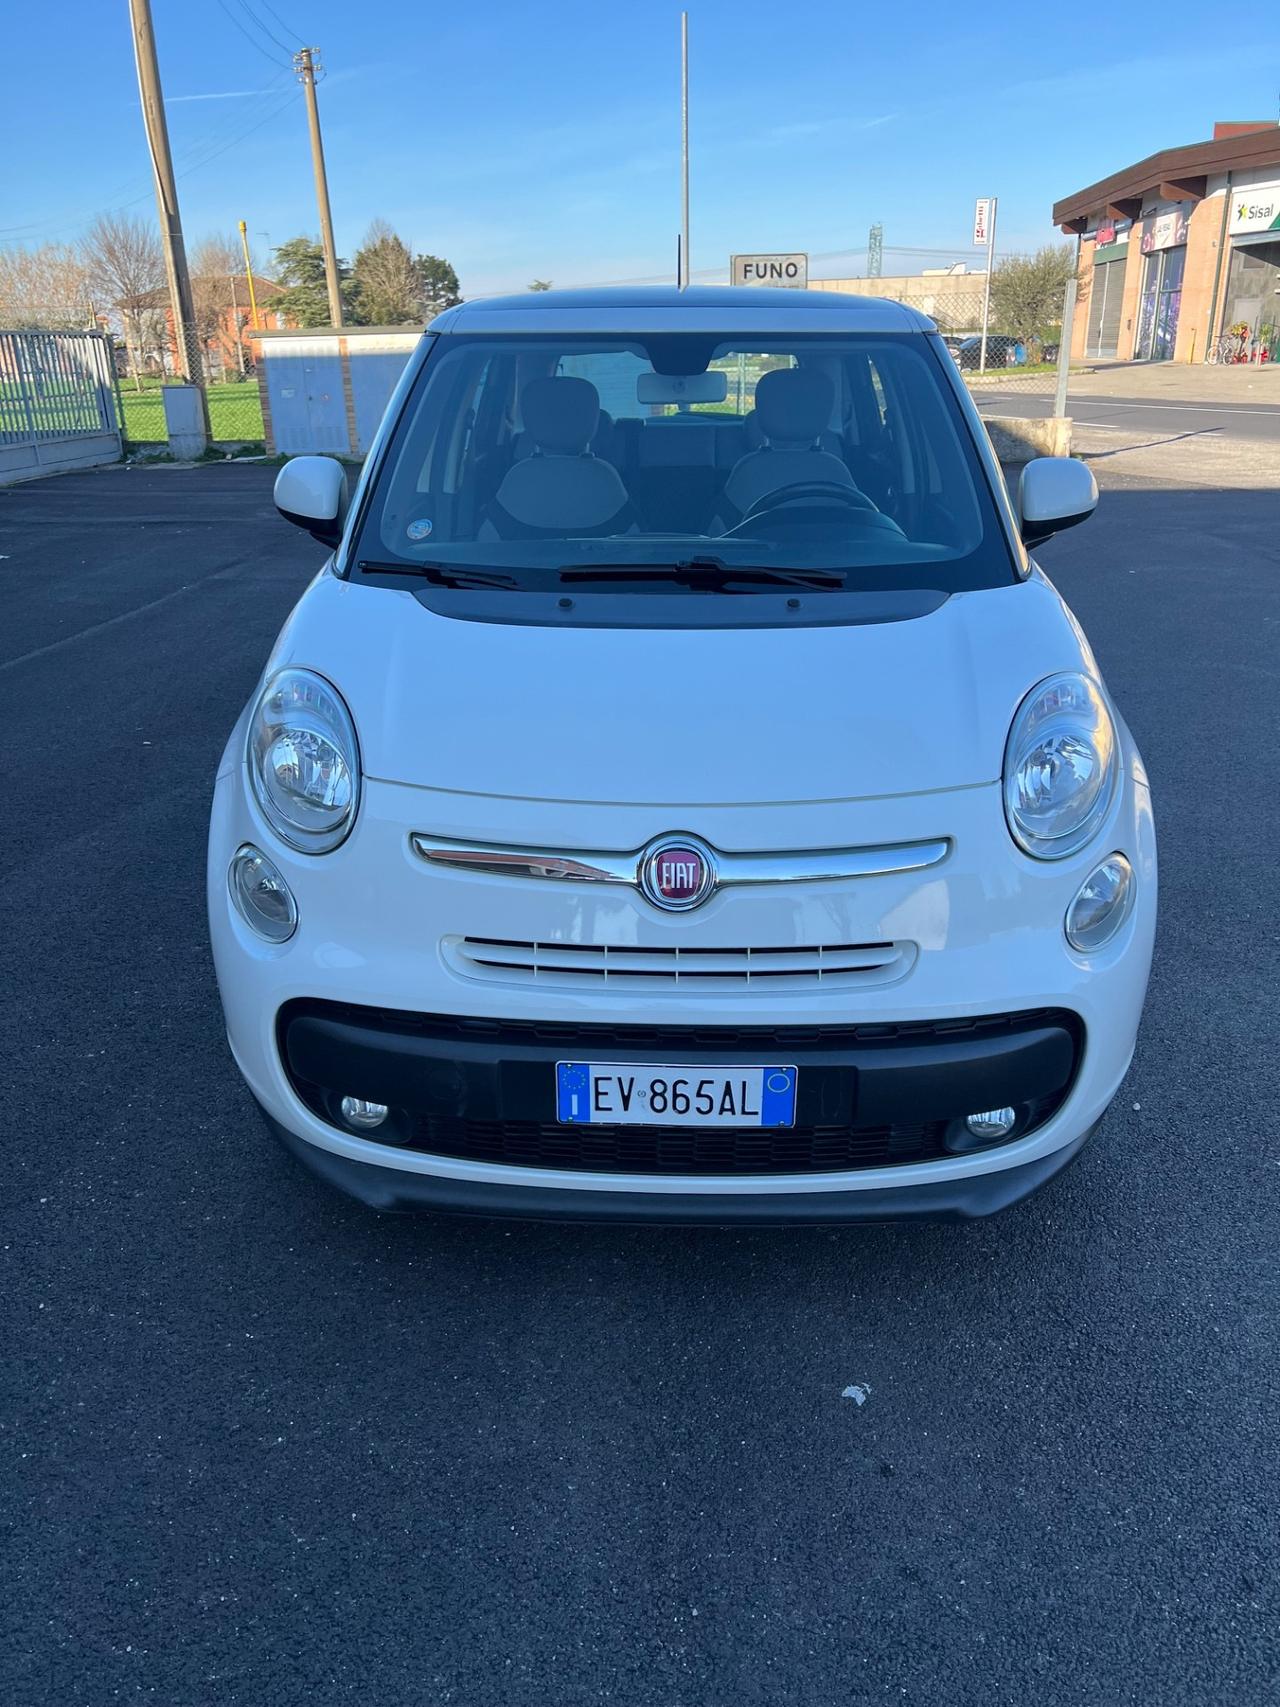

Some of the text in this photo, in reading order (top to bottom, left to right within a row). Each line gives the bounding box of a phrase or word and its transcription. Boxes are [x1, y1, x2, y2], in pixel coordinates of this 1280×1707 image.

[1248, 203, 1274, 220] Sisal
[743, 262, 798, 279] FUNO
[661, 862, 697, 889] FIAT
[594, 1076, 759, 1116] EV 865AL
